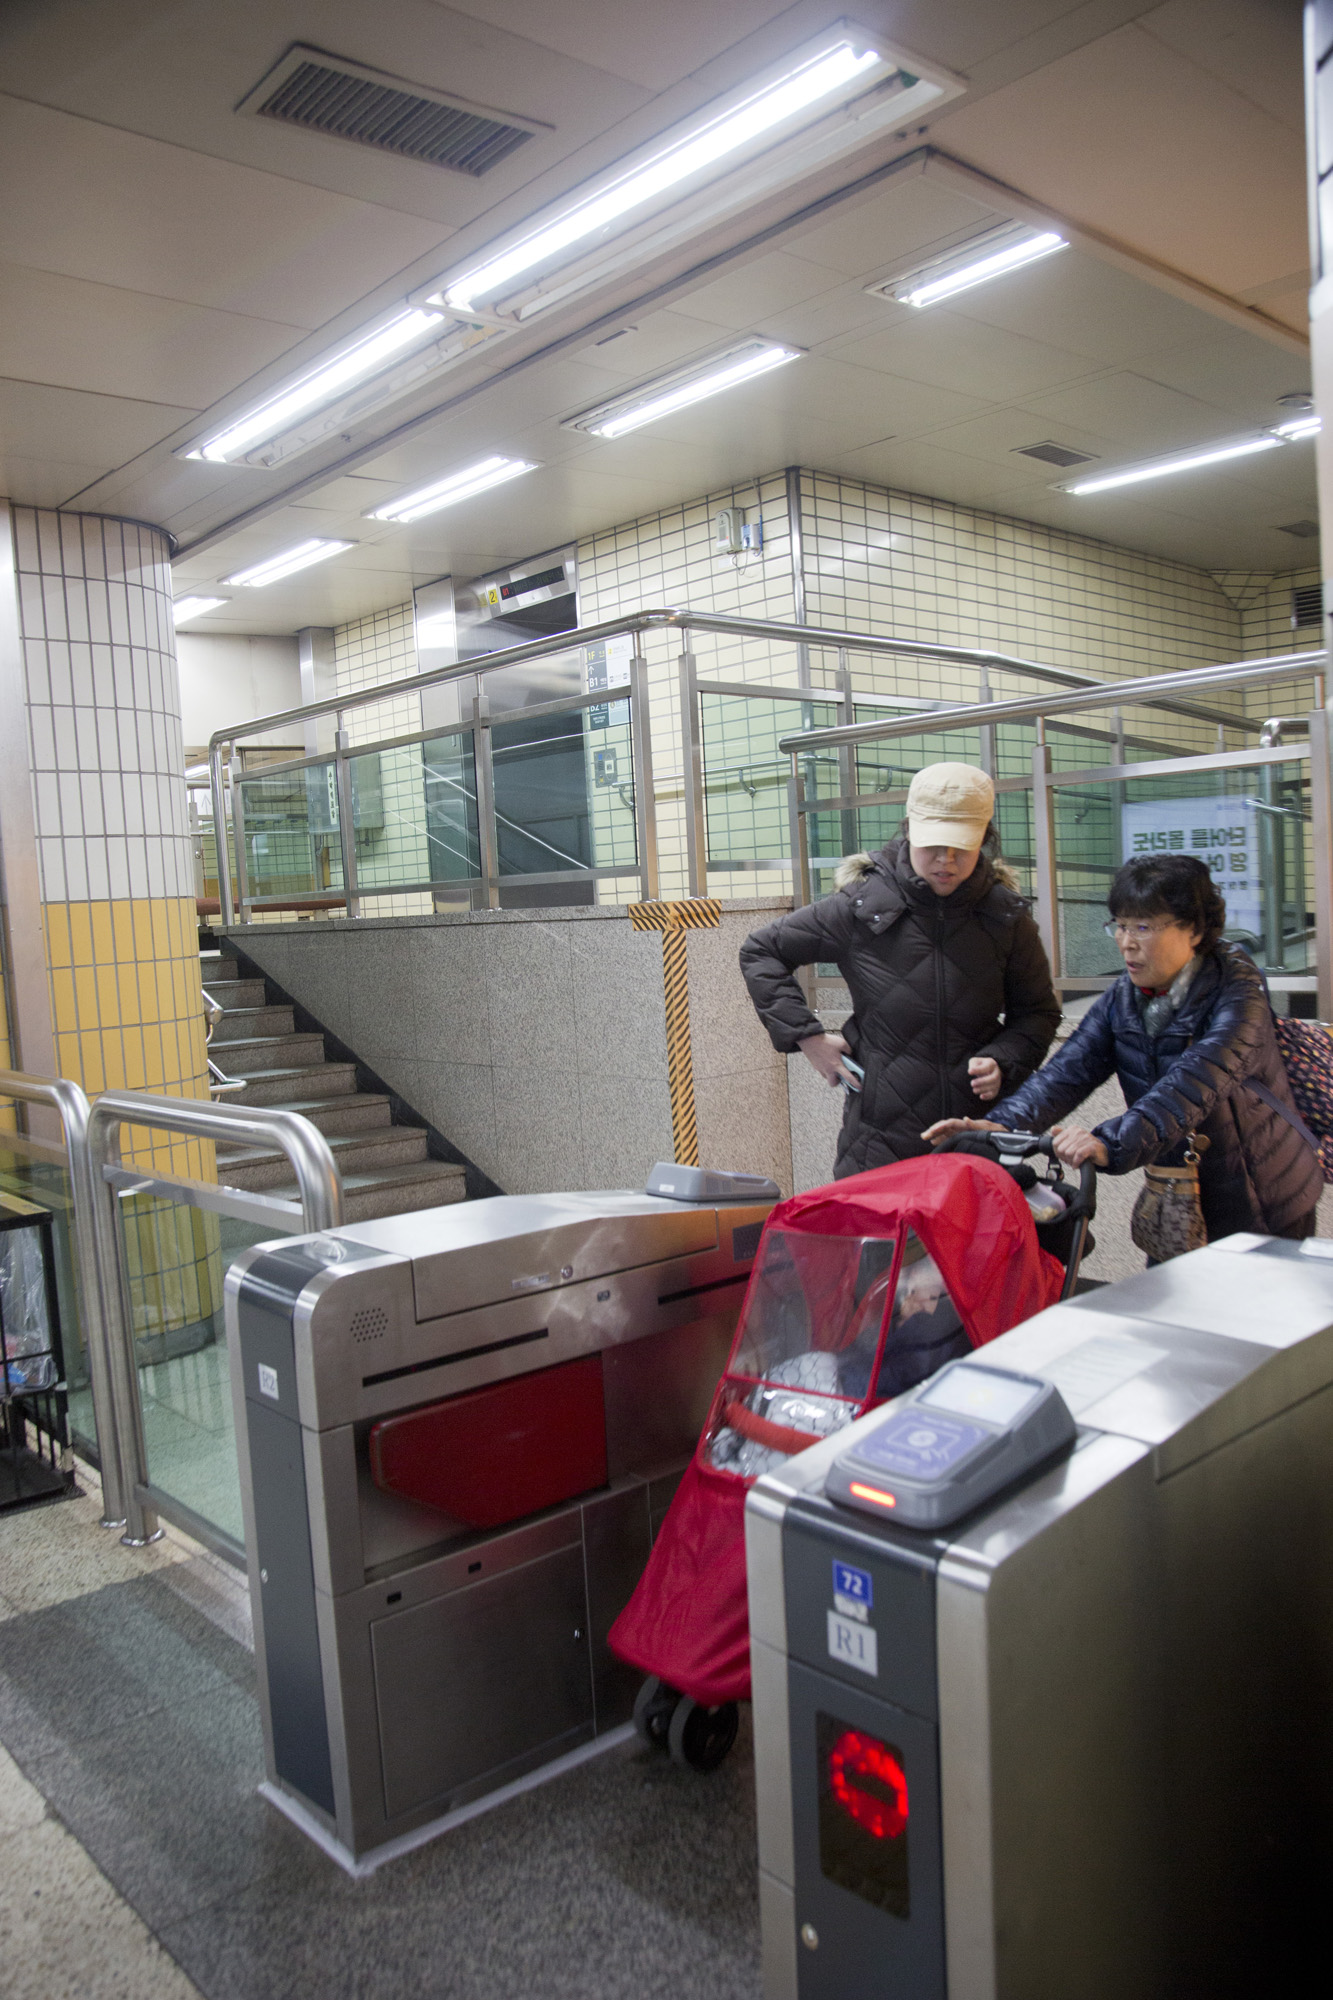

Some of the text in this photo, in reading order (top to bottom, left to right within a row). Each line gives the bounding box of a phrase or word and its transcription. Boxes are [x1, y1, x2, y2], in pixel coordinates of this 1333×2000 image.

[489, 591, 495, 603] 2
[587, 650, 595, 661] 1F
[589, 677, 598, 687] B1
[262, 1370, 275, 1392] R2
[842, 1570, 862, 1596] 72
[836, 1623, 865, 1660] R1
